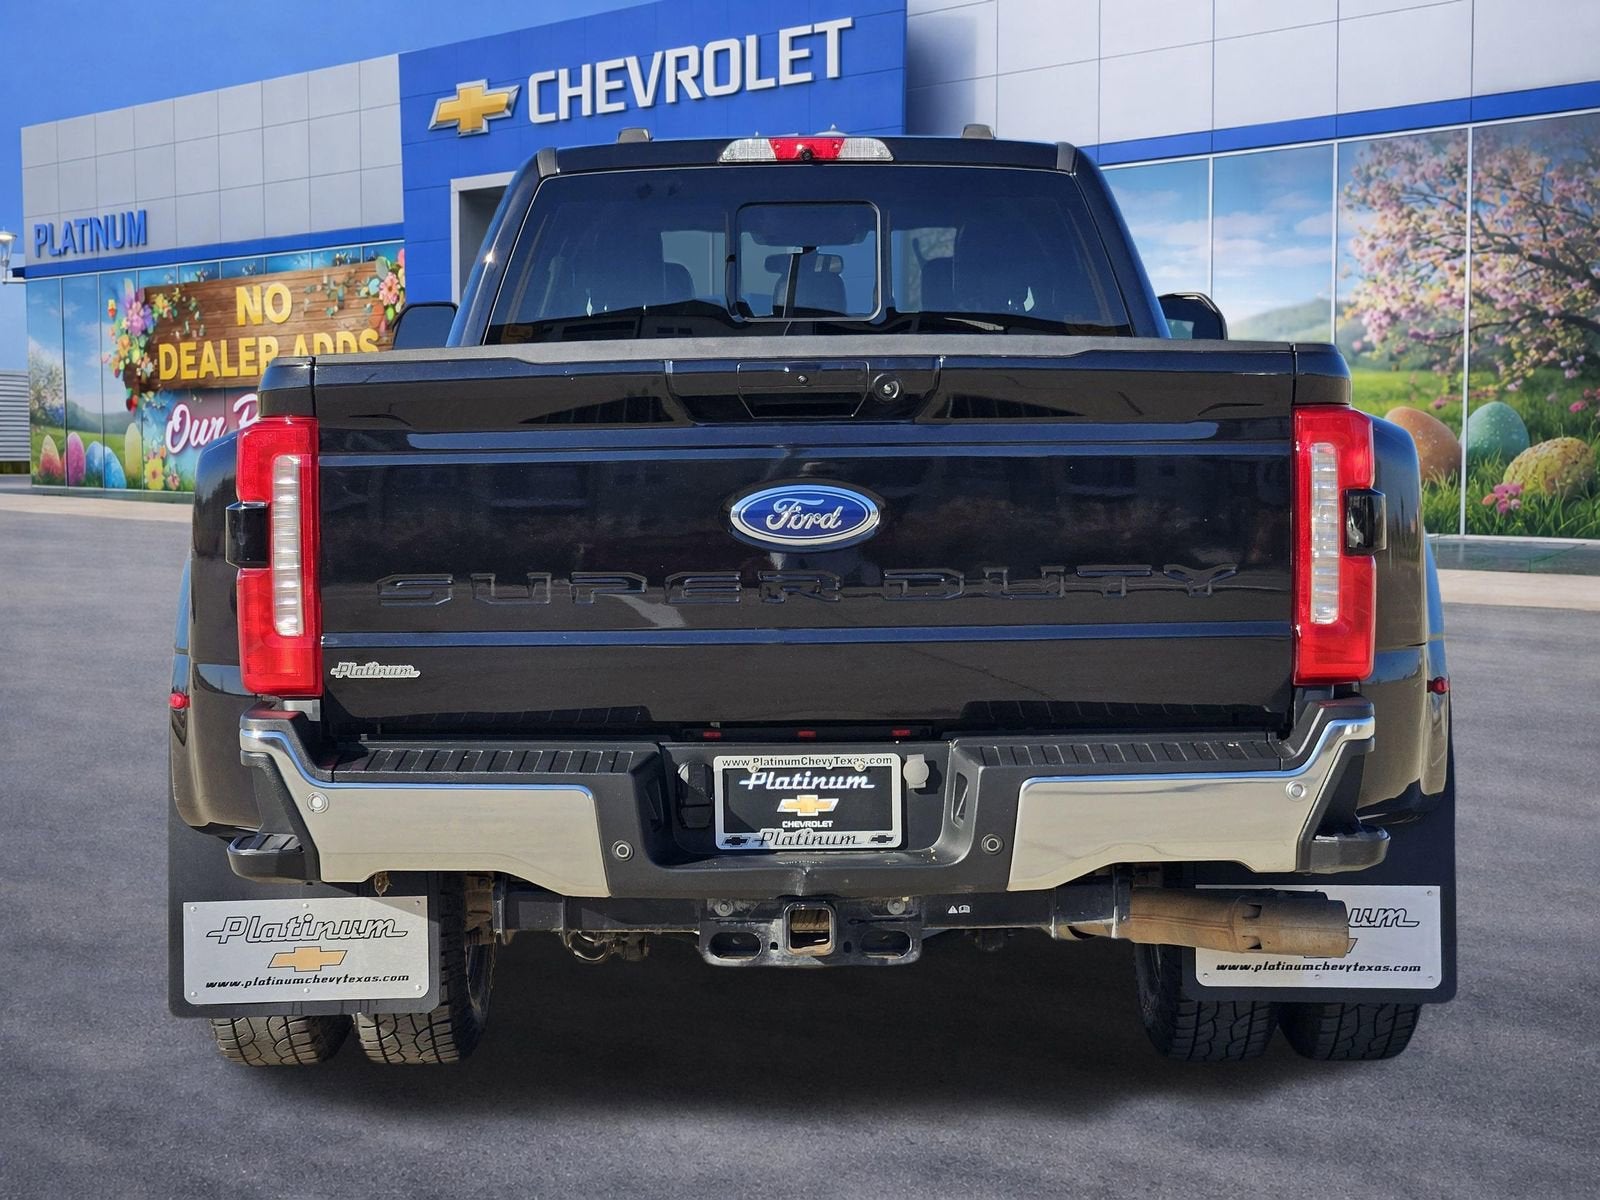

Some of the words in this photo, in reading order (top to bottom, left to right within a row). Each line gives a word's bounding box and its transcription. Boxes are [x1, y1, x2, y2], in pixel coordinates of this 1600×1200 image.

[528, 17, 854, 124] CHEVROLET
[34, 209, 147, 258] PLATINUM
[236, 282, 293, 326] NO
[158, 336, 279, 381] DEALER
[166, 404, 228, 453] Our
[766, 498, 843, 530] Ford
[377, 571, 841, 606] SUPER
[884, 564, 1238, 600] DUTY
[330, 661, 420, 678] Platinum
[722, 756, 892, 767] wwwPlatinumChevyTexas.com
[739, 771, 875, 790] Platinum
[752, 831, 862, 847] Platinum
[782, 820, 833, 828] CHEVROLET
[206, 913, 408, 944] Platinum
[205, 973, 410, 989] www.platinumchevytexas.com
[1216, 961, 1421, 973] www.platinumchevytexas.com
